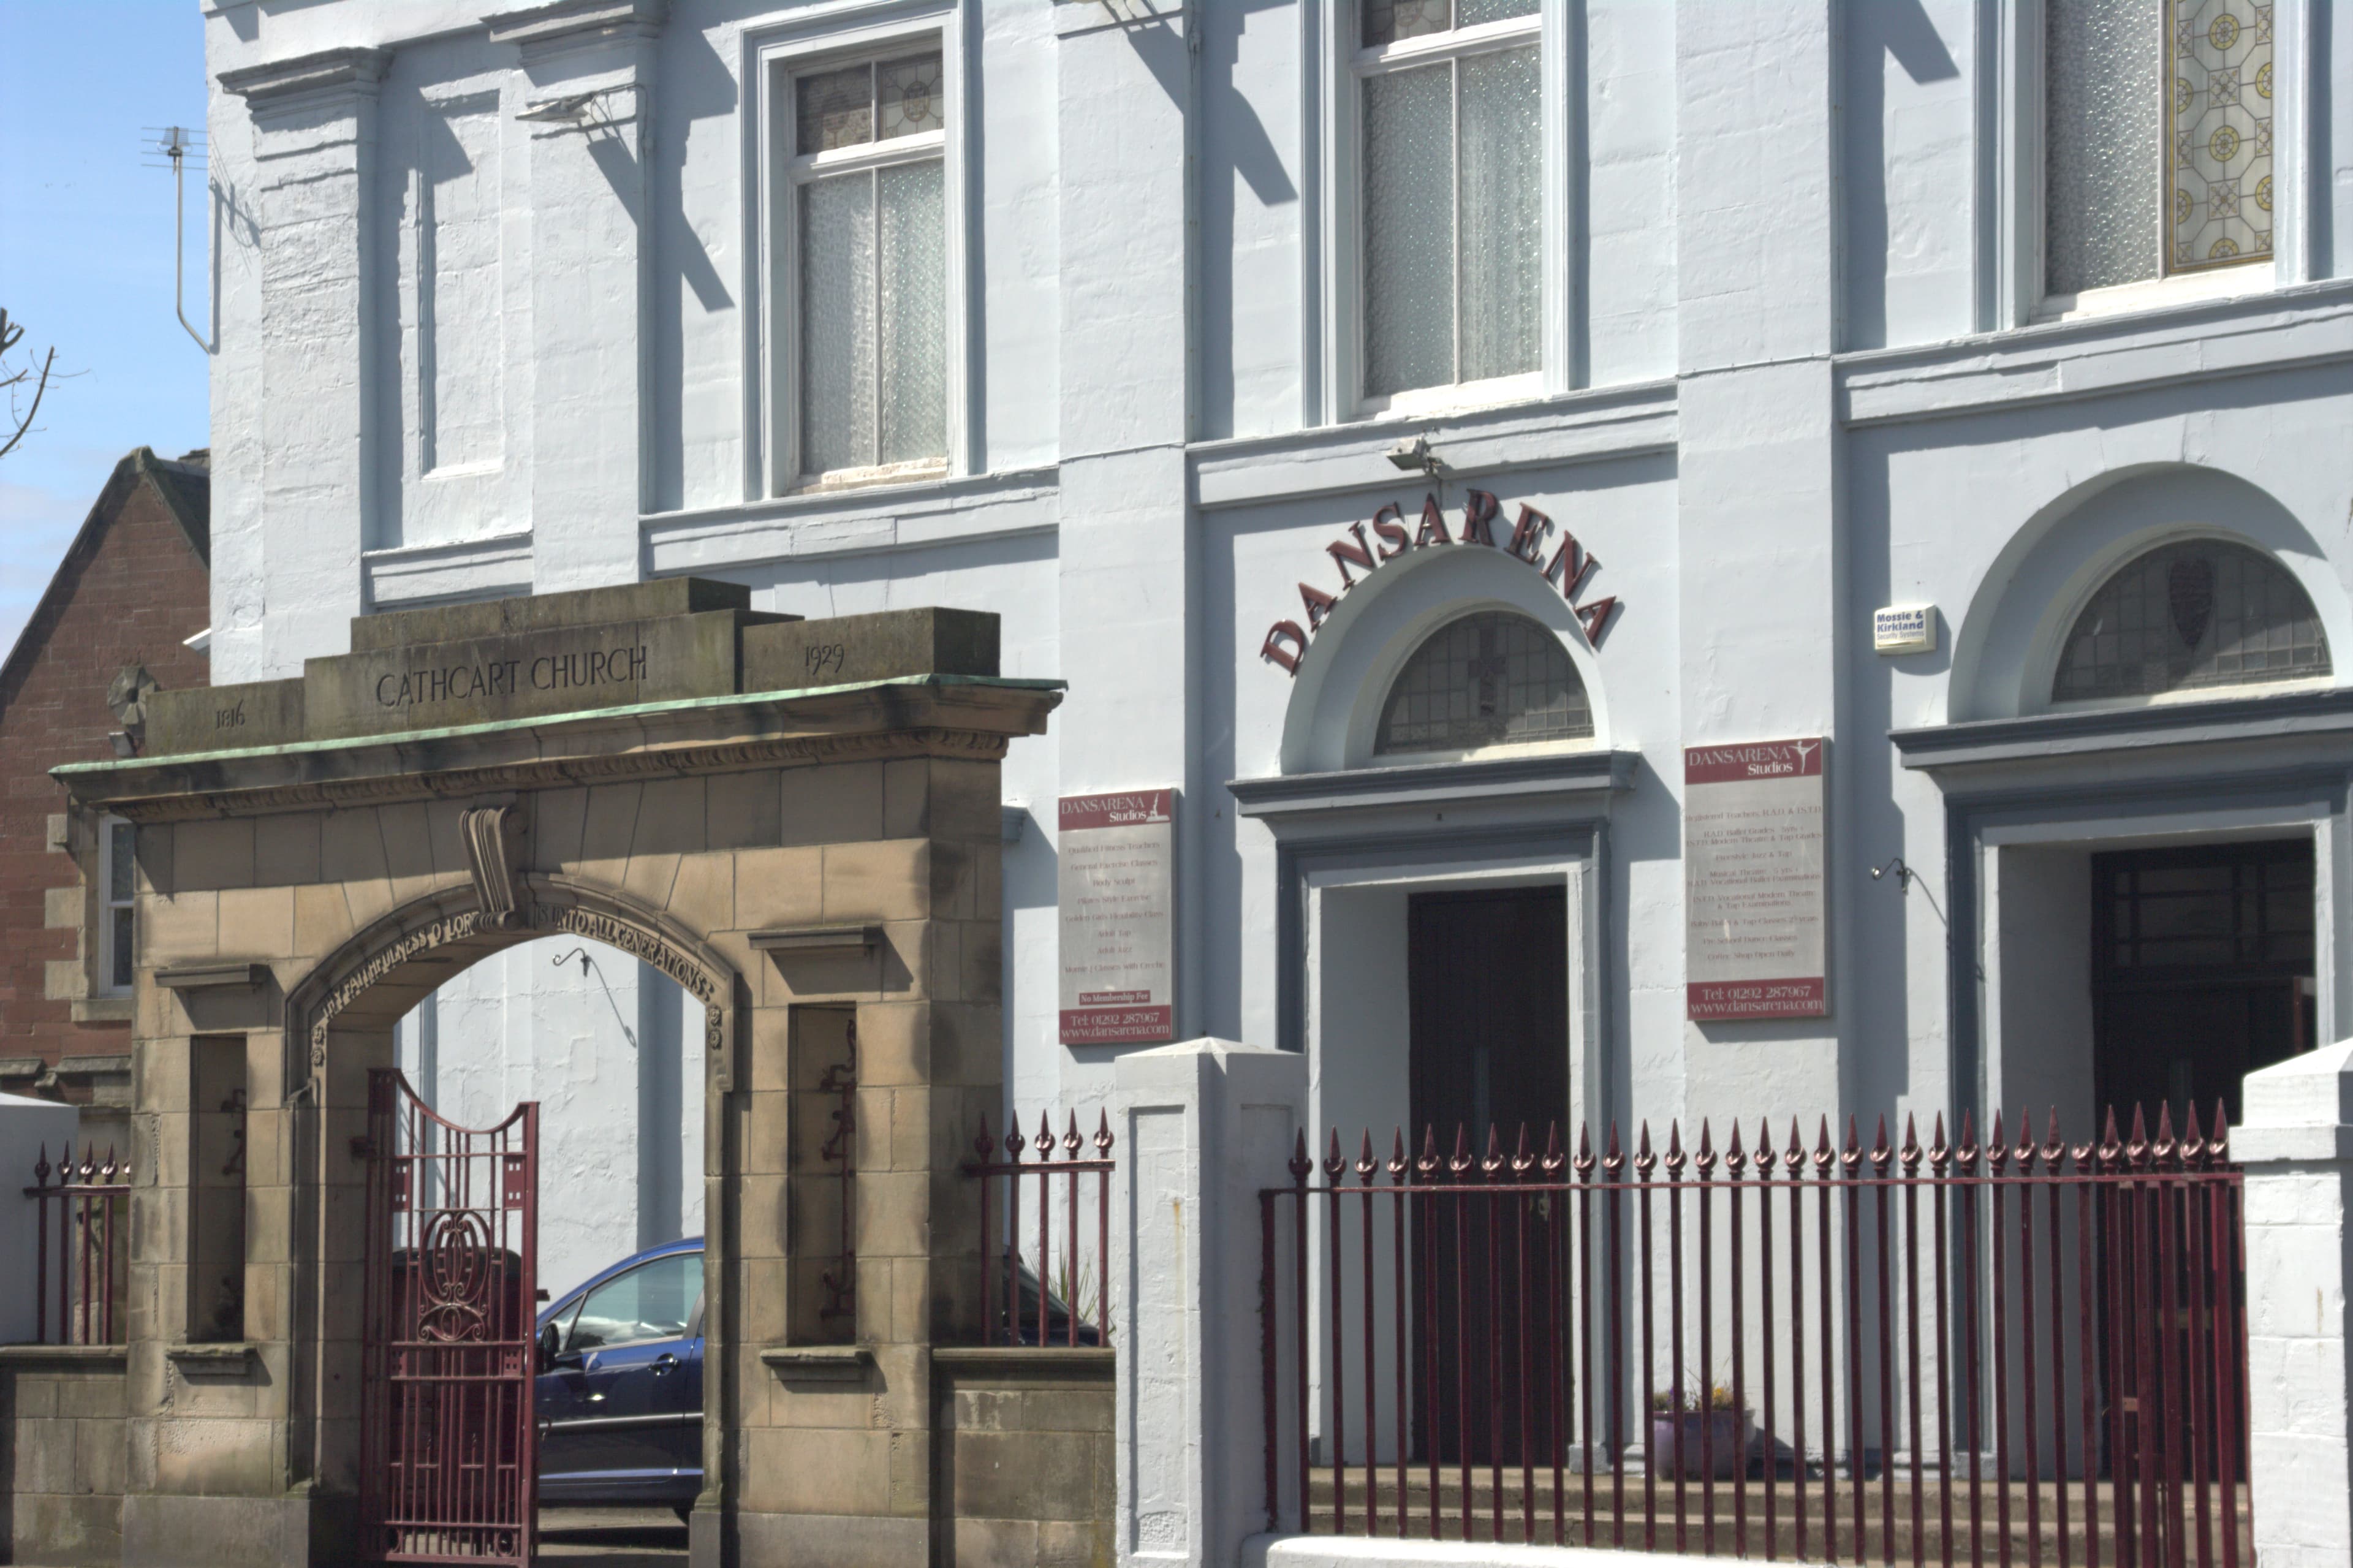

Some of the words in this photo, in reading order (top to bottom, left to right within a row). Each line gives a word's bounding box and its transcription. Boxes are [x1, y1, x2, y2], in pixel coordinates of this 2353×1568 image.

[1260, 489, 1616, 678] DANSARENA
[1877, 612, 1912, 623] Mossie
[1915, 610, 1923, 619] &
[1877, 620, 1924, 632] Kirkland
[1877, 632, 1898, 640] Security
[1900, 630, 1925, 638] Systems
[805, 643, 845, 675] 1929
[376, 660, 520, 708] CATHCART
[529, 645, 647, 692] CHURCH
[216, 699, 245, 729] 1816
[1689, 746, 1790, 766] DANSARENA
[1748, 762, 1793, 776] Studios
[1061, 796, 1145, 814] DANSARENA
[1109, 809, 1146, 822] Studios
[1686, 812, 1723, 822] Registered
[1779, 834, 1794, 843] Tap
[1716, 854, 1748, 862] Freestyle
[1778, 850, 1792, 858] Tap
[1093, 877, 1111, 887] Body
[1114, 877, 1135, 886] Sculpt
[1773, 873, 1821, 882] Examinations
[1717, 893, 1755, 902] Vocational
[1726, 901, 1740, 910] Tap
[1742, 899, 1791, 907] Examinations
[445, 911, 479, 938] LOR
[552, 906, 589, 933] UNTO
[589, 915, 617, 944] ALL
[1691, 920, 1709, 928] Baby
[1743, 918, 1757, 927] Tap
[1734, 951, 1752, 960] Shop
[1755, 950, 1775, 959] Open
[1778, 948, 1795, 958] Daily
[1093, 993, 1134, 1004] Membership
[1702, 989, 1724, 1001] Tel:
[1727, 987, 1762, 999] 01292
[1766, 985, 1811, 998] 287967
[1691, 999, 1822, 1014] www.dansarena.com
[1070, 1016, 1089, 1027] Tel:
[1091, 1014, 1120, 1025] 01292
[1123, 1012, 1159, 1024] 287967
[1061, 1025, 1169, 1039] www.dansarena.com
